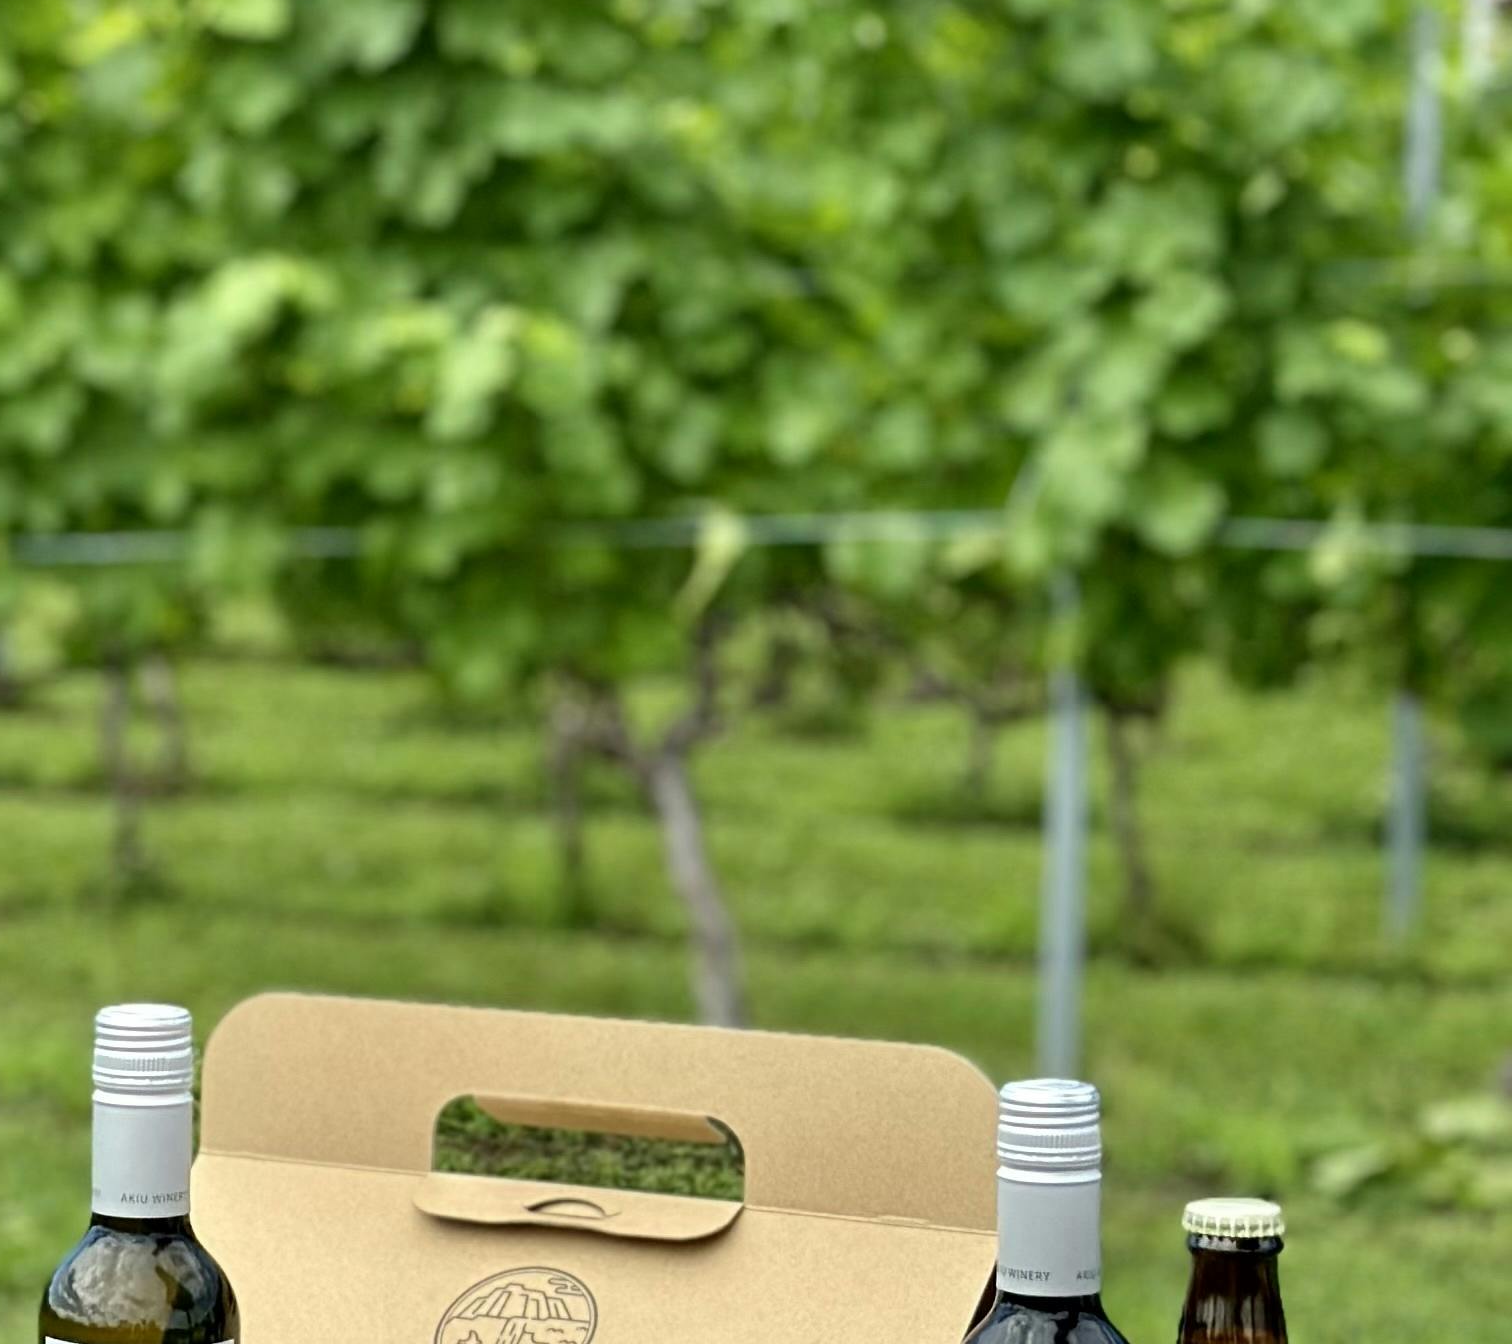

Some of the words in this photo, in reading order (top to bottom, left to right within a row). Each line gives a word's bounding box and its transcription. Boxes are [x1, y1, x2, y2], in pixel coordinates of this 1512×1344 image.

[120, 1192, 149, 1205] AKIU
[151, 1191, 187, 1205] WINER
[1008, 1267, 1050, 1281] WINERY
